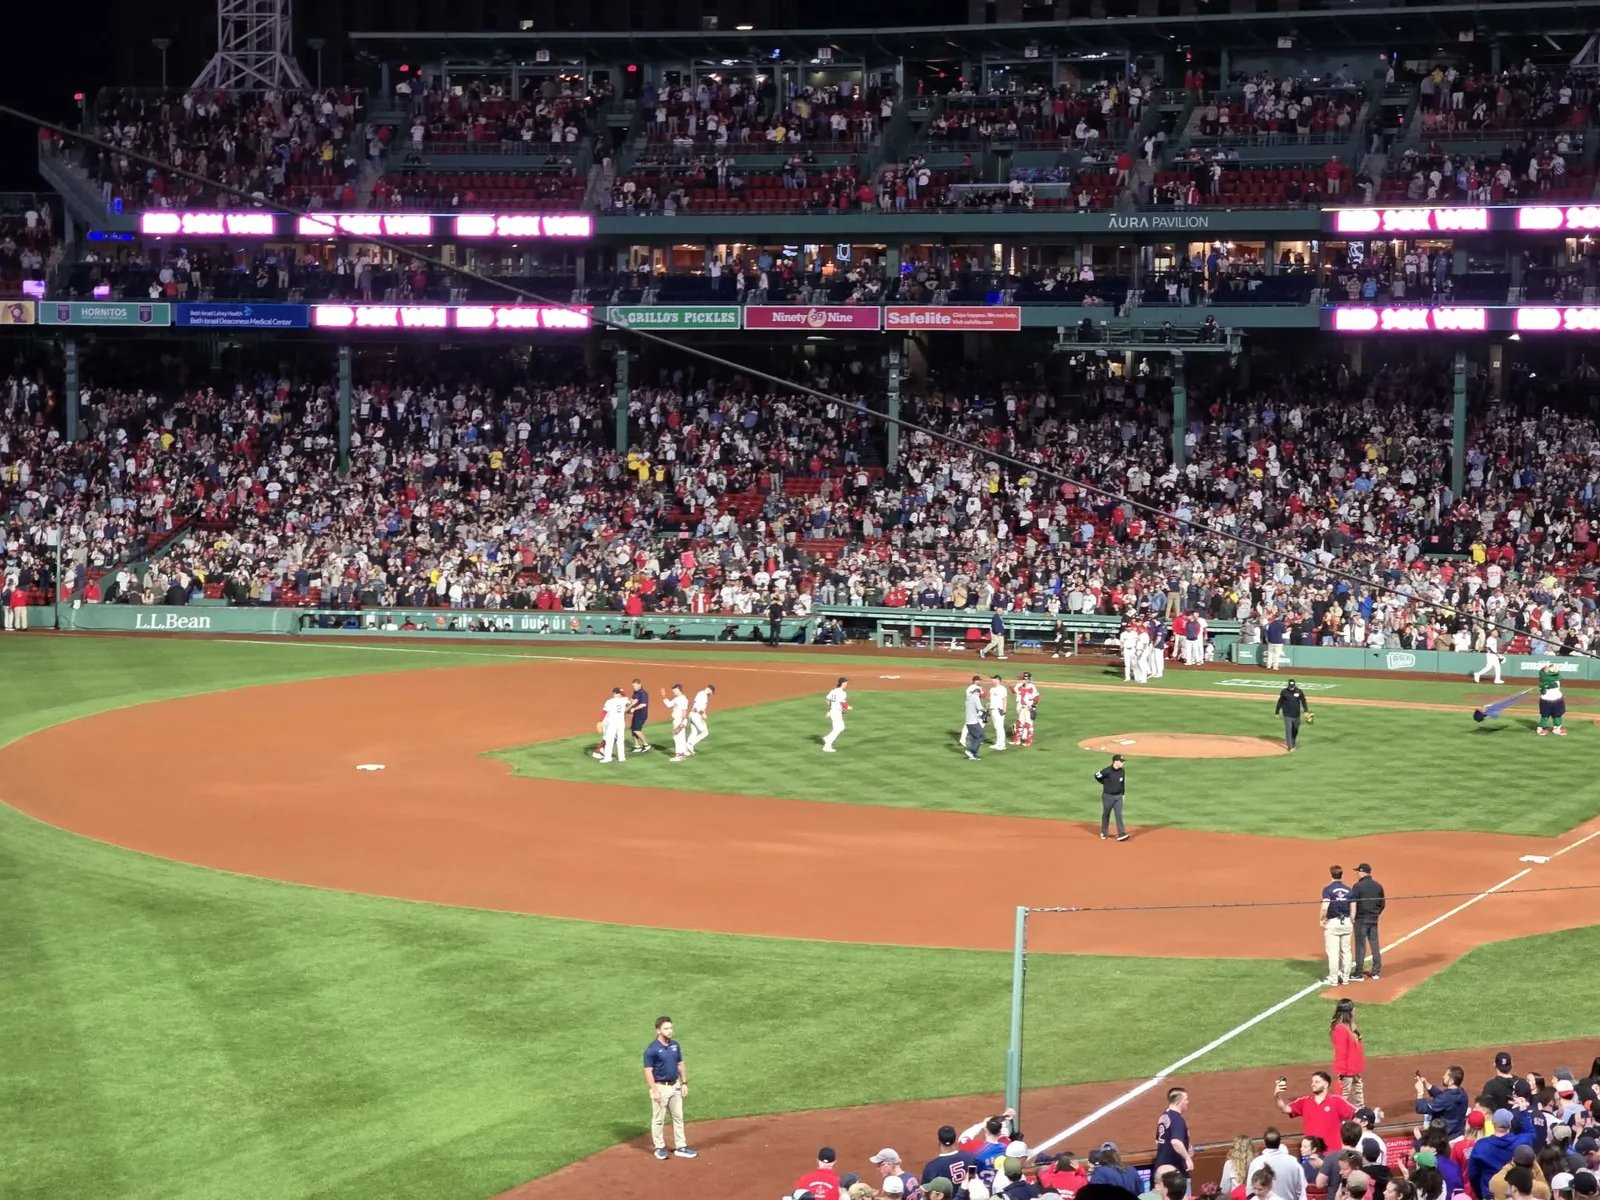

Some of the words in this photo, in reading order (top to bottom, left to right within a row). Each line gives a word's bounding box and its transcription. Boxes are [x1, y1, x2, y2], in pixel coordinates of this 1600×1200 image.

[1152, 216, 1209, 228] PAVILION
[81, 307, 128, 317] HORNITOS
[628, 312, 679, 323] GRILLO'S
[684, 312, 736, 323] PICKLES
[772, 312, 807, 324] Ninety
[827, 313, 853, 322] Nine
[888, 312, 951, 325] Safelite
[135, 613, 211, 629] L.L.Bean
[949, 1160, 967, 1184] 5
